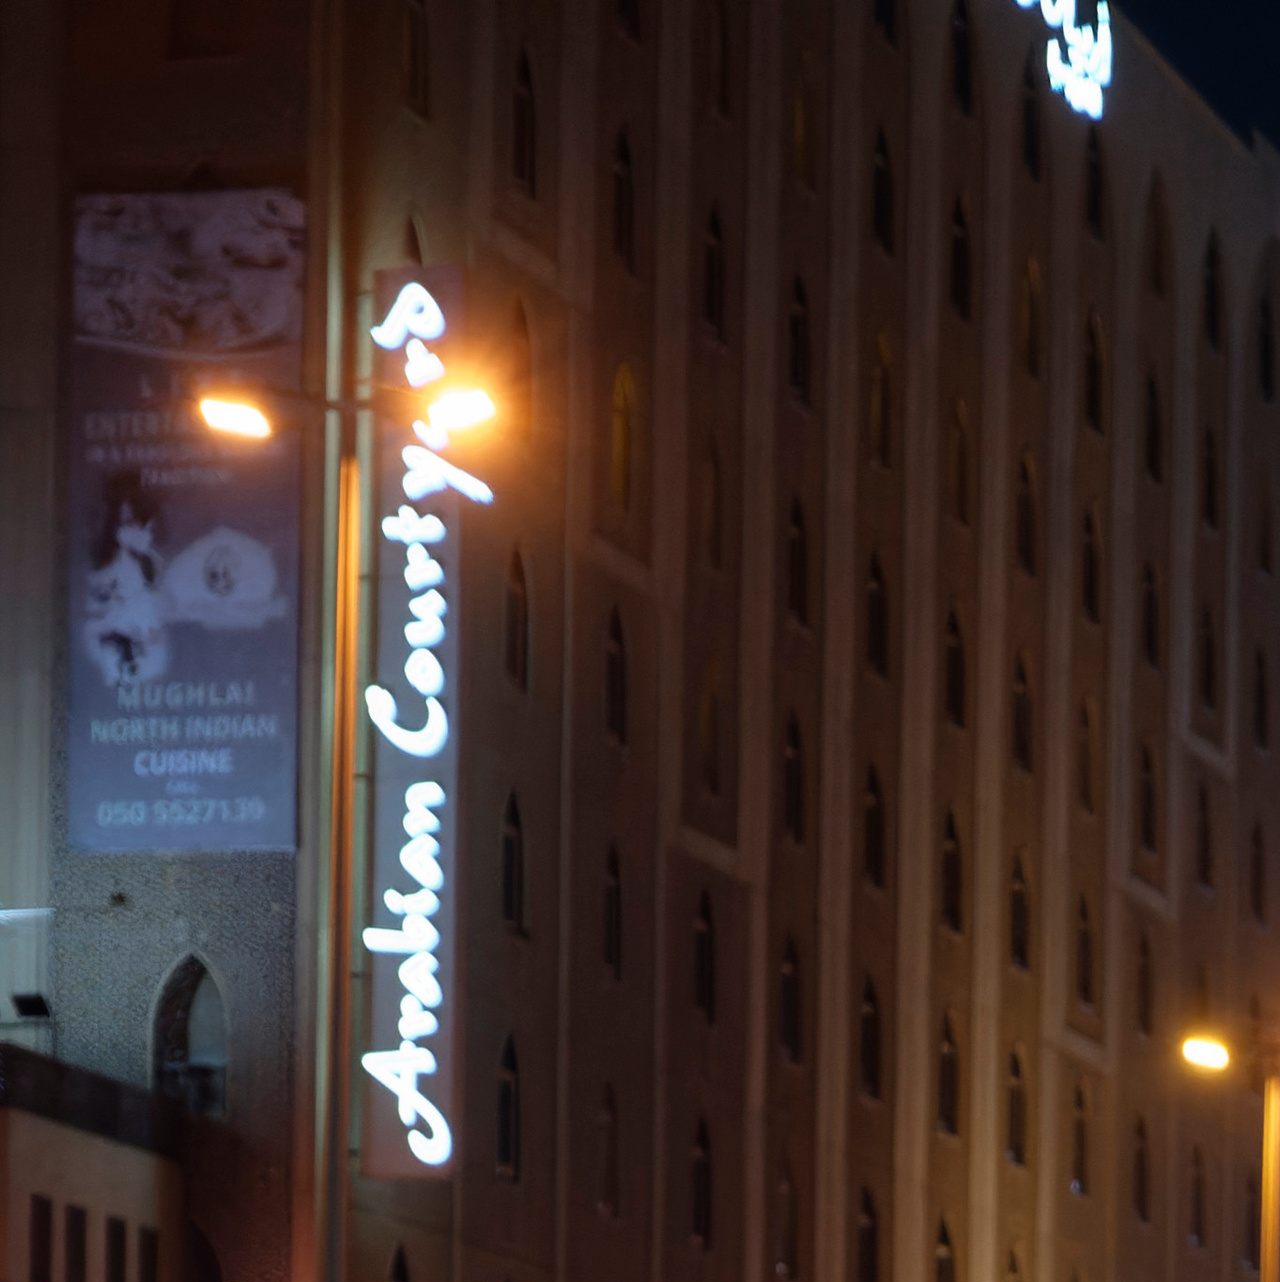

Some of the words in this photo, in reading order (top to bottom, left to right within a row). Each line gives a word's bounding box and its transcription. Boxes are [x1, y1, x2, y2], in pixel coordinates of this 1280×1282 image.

[117, 680, 255, 710] MUGHLAI
[90, 716, 180, 744] NORTH
[185, 713, 278, 740] INDIAN
[133, 748, 234, 777] CUISINE
[361, 780, 452, 1166] Arabian
